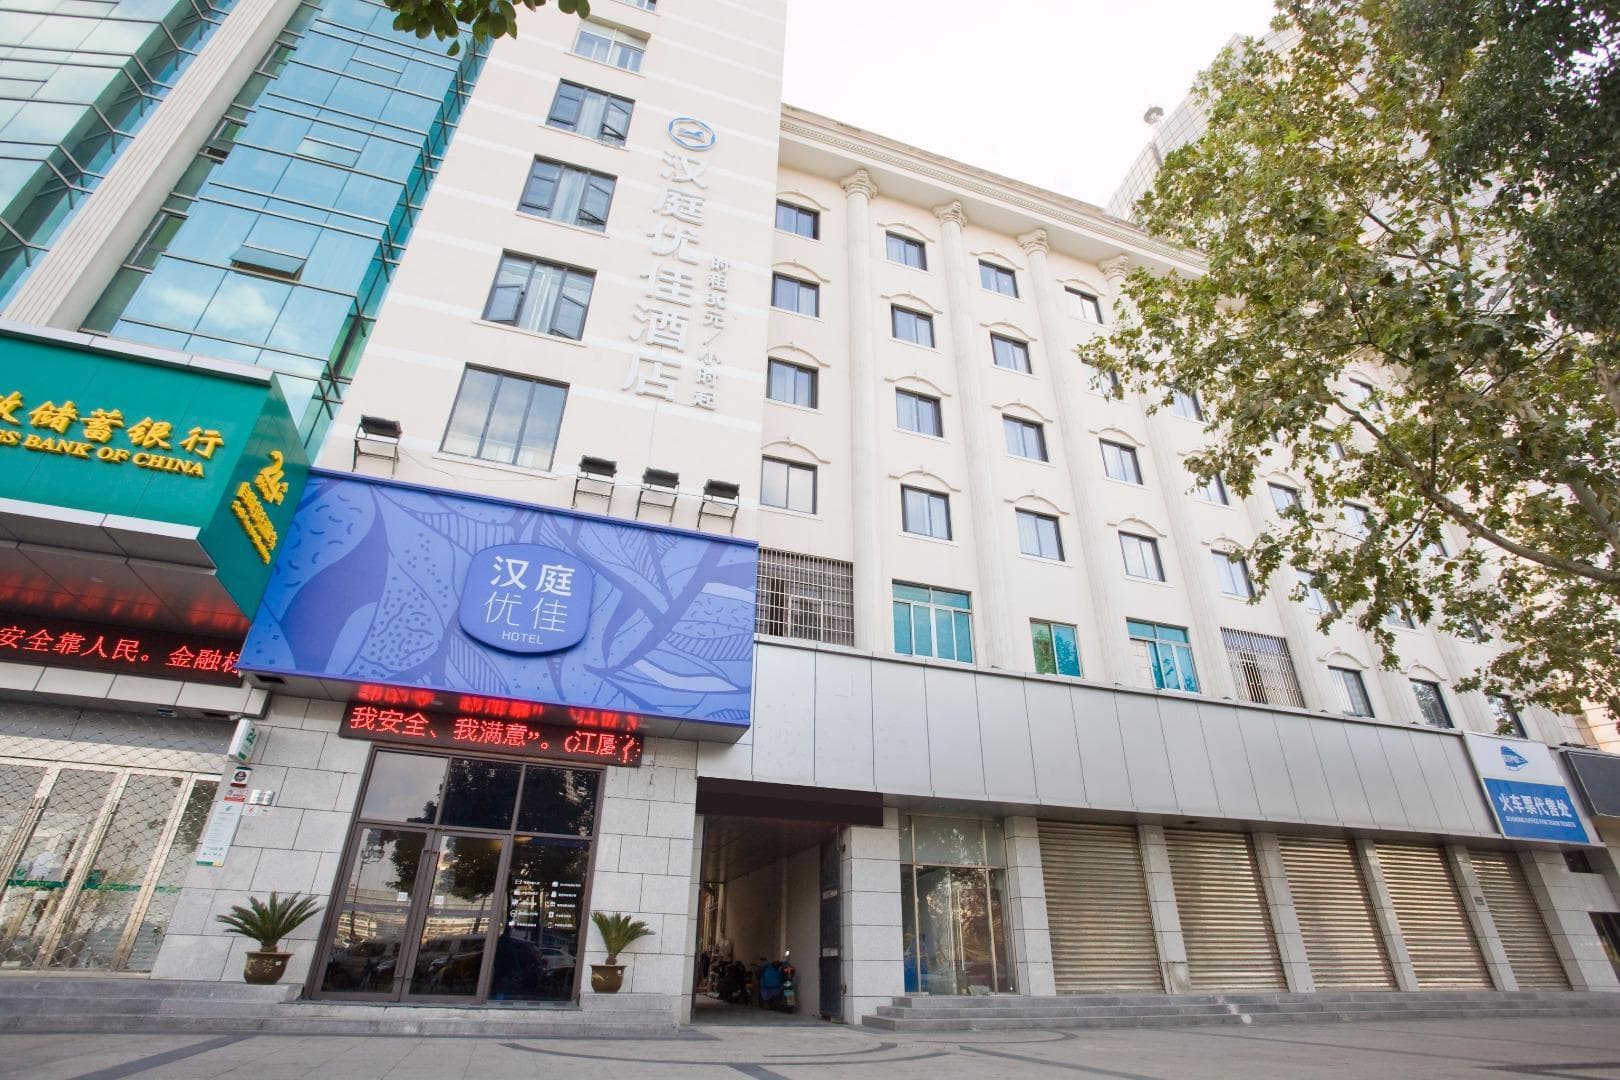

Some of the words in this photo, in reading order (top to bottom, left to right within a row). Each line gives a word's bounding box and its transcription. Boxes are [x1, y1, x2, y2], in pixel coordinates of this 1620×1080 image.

[621, 150, 708, 402] 汉庭优佳酒店
[23, 434, 94, 459] BANK
[96, 446, 130, 464] OF
[132, 452, 205, 477] CHINA
[490, 556, 575, 596] 汉庭
[484, 591, 567, 632] 优佳
[502, 631, 543, 645] HOTEL
[1498, 793, 1572, 818] 火车票代售处
